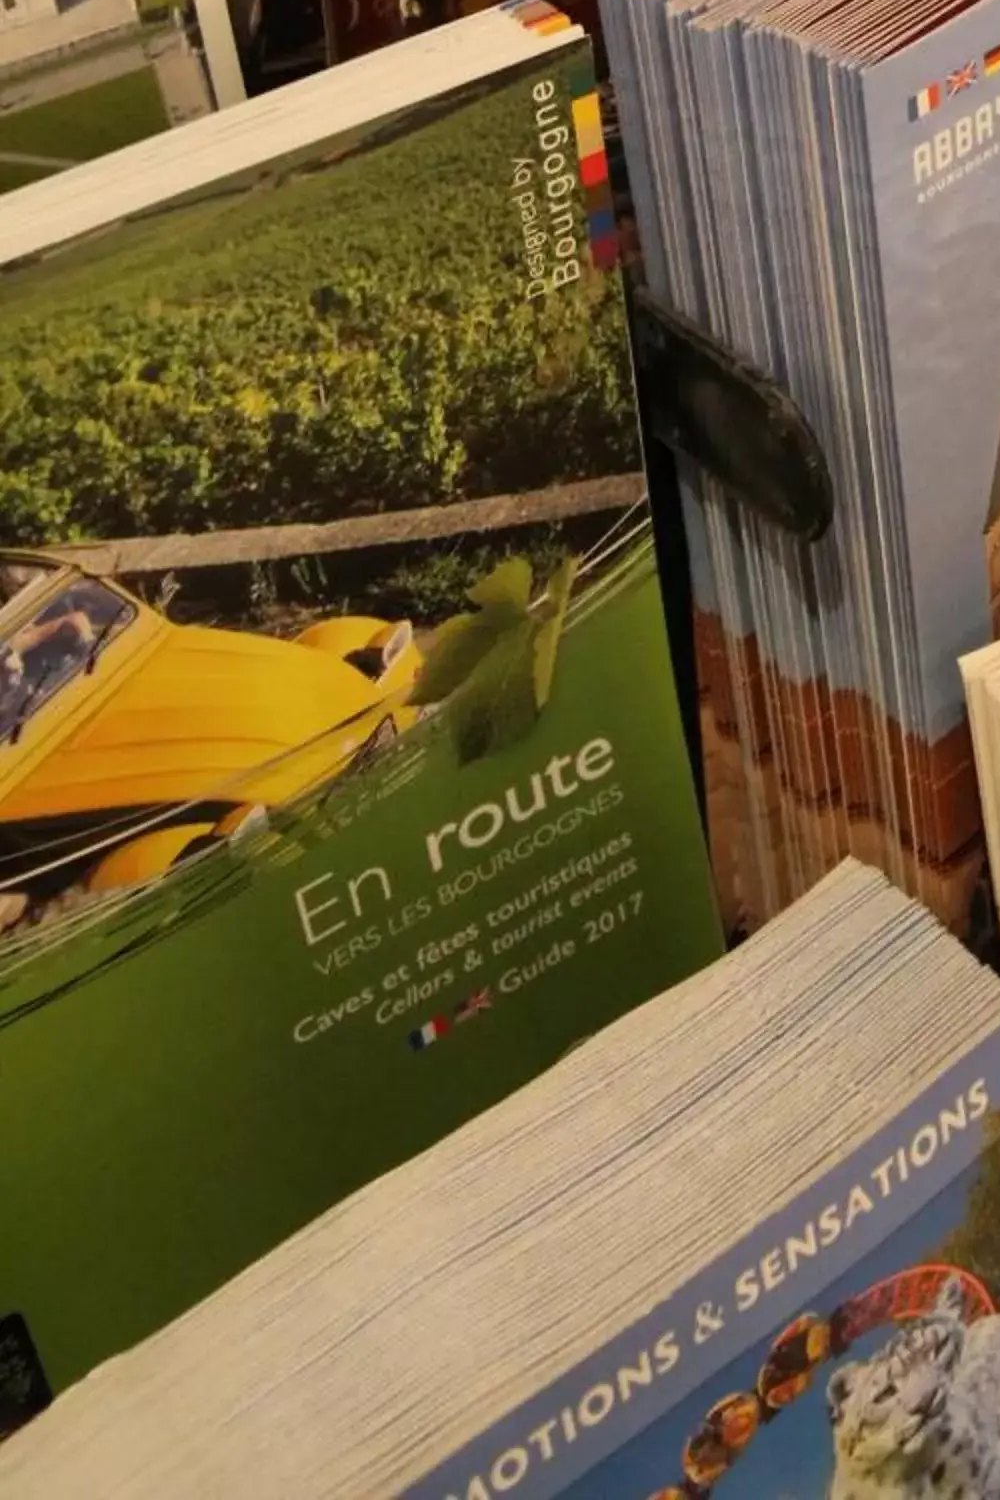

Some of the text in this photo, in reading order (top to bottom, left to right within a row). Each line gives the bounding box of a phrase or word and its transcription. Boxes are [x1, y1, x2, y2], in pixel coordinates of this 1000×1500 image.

[510, 156, 549, 301] Designed by
[532, 78, 582, 290] Bourgogne
[292, 830, 635, 1045] Caves et fêtes touristiques
[293, 736, 616, 947] En route
[311, 781, 626, 978] VERS LES BOURGOGNES
[374, 855, 640, 1027] Cellars & tourist events
[497, 890, 646, 995] Guide 2017
[692, 1302, 726, 1346] &
[734, 1077, 992, 1314] SENSATIONS
